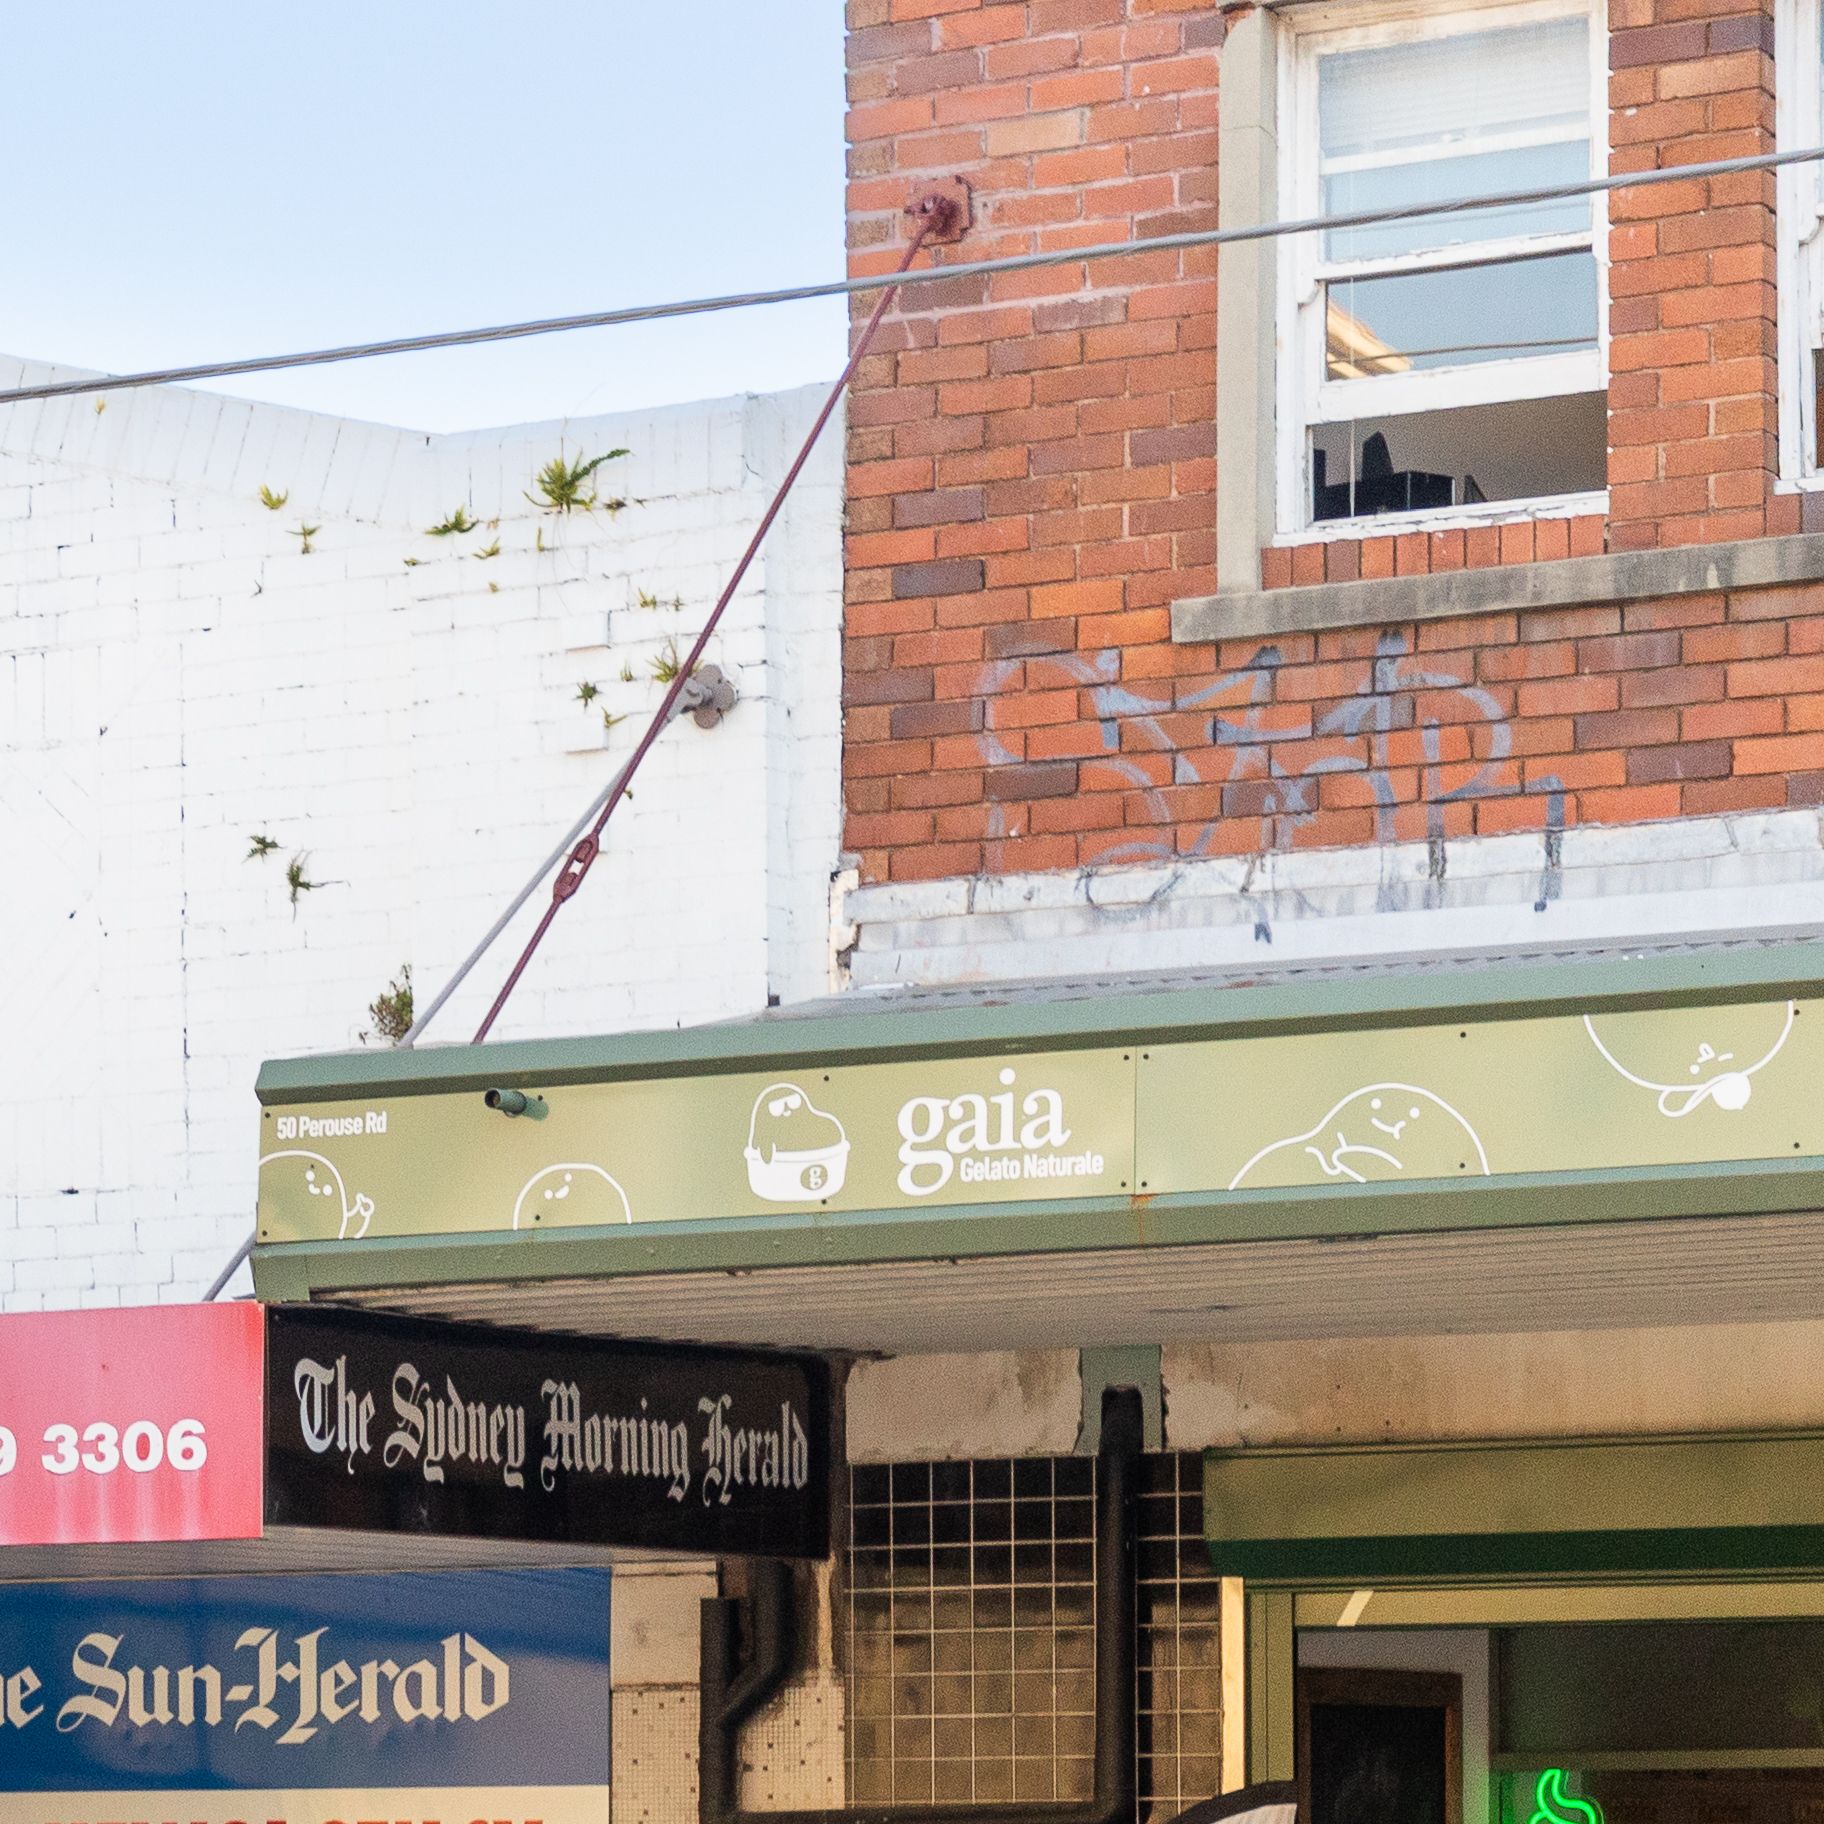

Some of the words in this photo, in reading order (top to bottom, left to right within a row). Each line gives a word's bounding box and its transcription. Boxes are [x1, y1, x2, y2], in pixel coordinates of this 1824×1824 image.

[276, 1116, 298, 1140] 50
[298, 1112, 364, 1139] Perouse
[365, 1111, 388, 1136] Rd
[895, 1067, 1073, 1198] gaia
[960, 1156, 1020, 1182] Gelato
[1022, 1149, 1105, 1178] Naturale
[41, 1417, 209, 1476] 3306
[293, 1354, 376, 1475] The
[383, 1361, 526, 1491] Sydney
[539, 1378, 691, 1503] Morning
[697, 1393, 810, 1508] Herald
[54, 1625, 512, 1746] Sun-Herald
